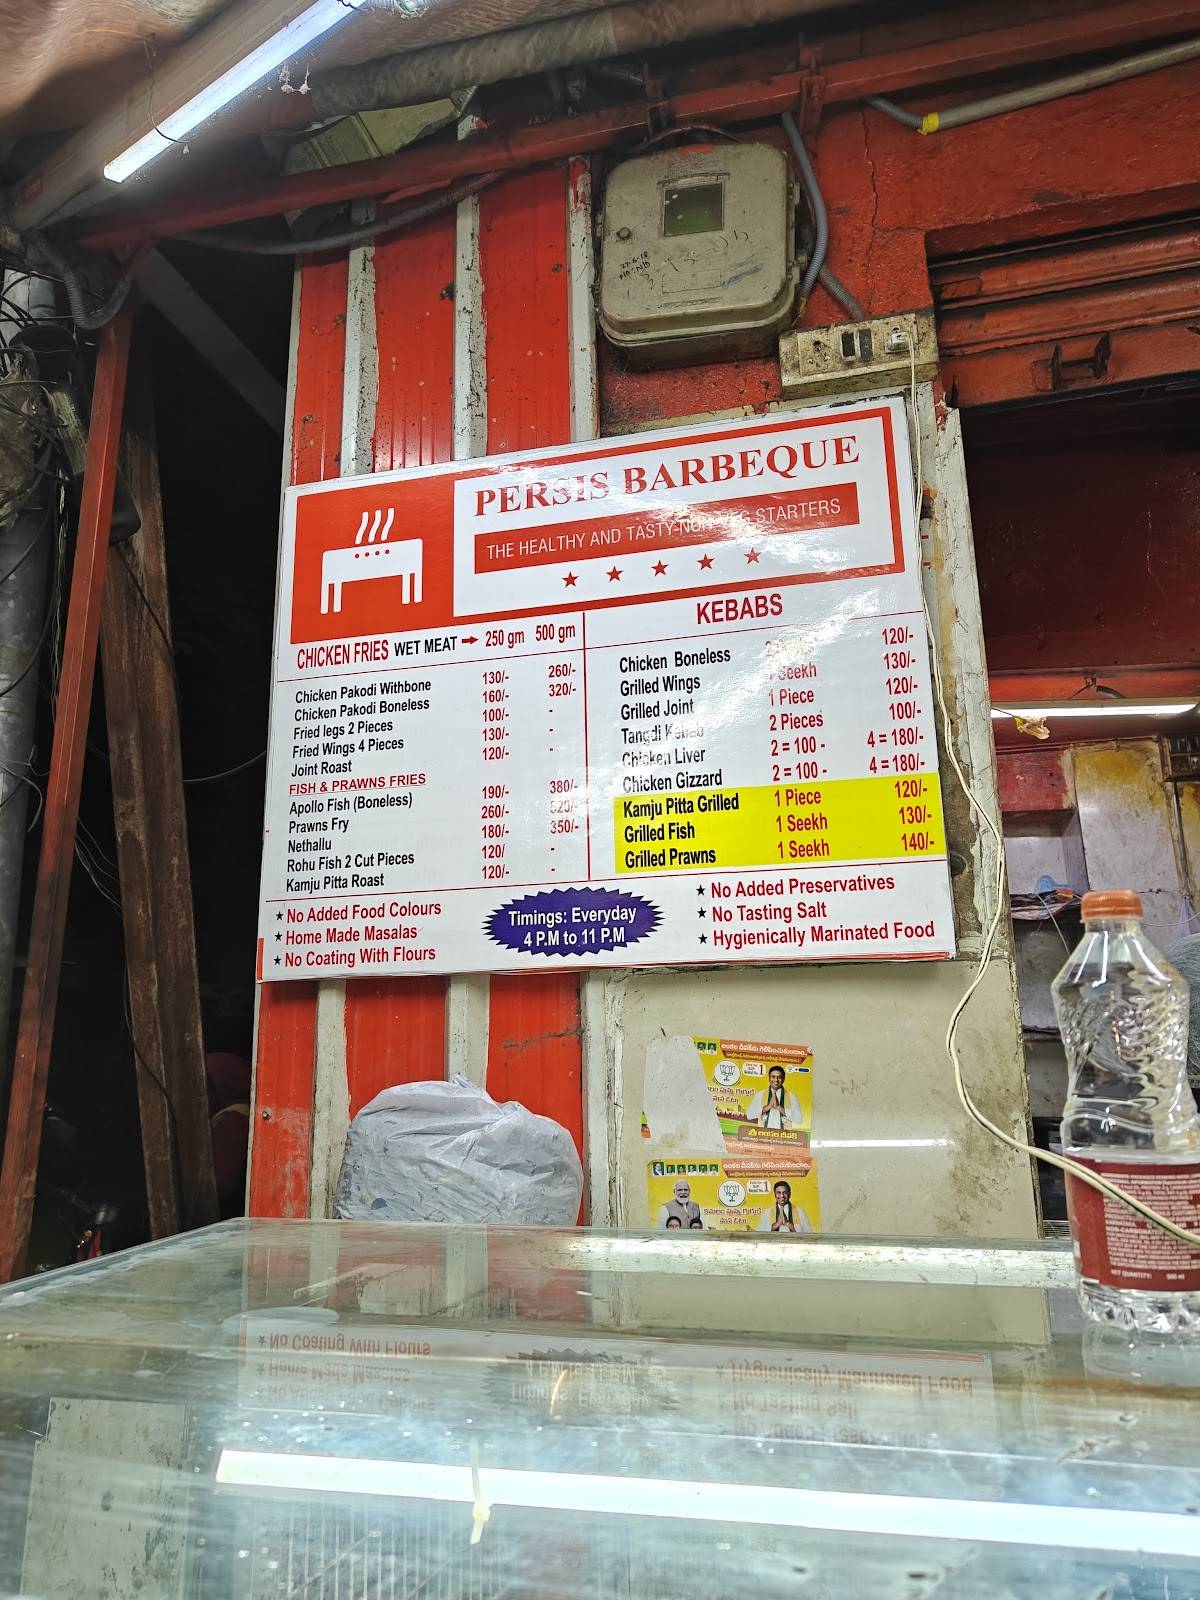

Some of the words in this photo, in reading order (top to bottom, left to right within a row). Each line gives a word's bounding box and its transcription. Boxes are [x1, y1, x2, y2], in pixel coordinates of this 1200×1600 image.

[474, 472, 609, 516] PERSIS
[624, 436, 859, 494] BARBEQUE
[487, 543, 514, 559] THE
[519, 532, 586, 555] HEALTHY
[590, 529, 621, 545] AND
[756, 498, 841, 523] STARTERS
[697, 593, 782, 624] KEBABS
[297, 644, 350, 669] CHICKEN
[354, 639, 388, 663] FRIES
[394, 640, 421, 656] WET
[425, 636, 457, 653] MEAT
[486, 629, 504, 647] 250
[508, 631, 524, 649] gm
[536, 624, 554, 641] 500
[558, 625, 575, 643] gm
[620, 655, 667, 673] Chicken
[675, 648, 730, 667] Boneless
[882, 626, 913, 645] 120/-
[296, 689, 337, 703] Chicken
[341, 683, 376, 699] Pakodi
[380, 680, 431, 695] Withbone
[483, 670, 509, 684] 130/-
[548, 663, 576, 678] 260/-
[620, 677, 659, 696] Grilled
[662, 675, 700, 694] Wings
[884, 651, 916, 669] 130/-
[295, 707, 336, 721] Chicken
[340, 702, 376, 717] Pakodi
[380, 698, 429, 713] Boneless
[483, 689, 509, 703] 160/-
[549, 682, 576, 697] 320/-
[621, 701, 660, 720] Grilled
[664, 698, 694, 716] Joint
[769, 689, 774, 706] 1
[780, 688, 814, 705] Piece
[886, 676, 918, 695] 120/-
[294, 725, 320, 740] Fried
[323, 724, 345, 739] legs
[348, 722, 354, 734] 2
[358, 721, 393, 733] Pieces
[483, 707, 509, 722] 100/-
[770, 714, 777, 731] 2
[781, 713, 823, 730] Pieces
[889, 701, 921, 720] 100/-
[293, 744, 319, 758] Fried
[322, 742, 355, 757] Wings
[358, 739, 365, 752] 4
[368, 738, 404, 751] Pieces
[483, 726, 509, 741] 130/-
[675, 747, 705, 764] Liver
[771, 740, 778, 756] 2
[782, 743, 790, 751] =
[794, 736, 816, 754] 100
[867, 731, 875, 748] 4
[879, 735, 887, 743] =
[892, 727, 923, 746] 180/-
[291, 763, 318, 777] Joint
[321, 760, 352, 774] Roast
[483, 746, 509, 760] 120/-
[623, 775, 672, 793] Chicken
[676, 769, 722, 789] Gizzard
[773, 764, 780, 781] 2
[784, 768, 792, 776] =
[796, 761, 818, 779] 100
[870, 756, 877, 773] 4
[881, 760, 889, 769] =
[893, 753, 925, 772] 180/-
[290, 782, 316, 796] FISH
[320, 782, 328, 792] &
[332, 777, 386, 792] PRAWNS
[388, 773, 426, 788] FRIES
[290, 800, 324, 817] Apollo
[327, 797, 350, 811] Fish
[351, 790, 412, 813] (Boneless)
[482, 784, 509, 799] 190/-
[550, 779, 578, 794] 380/-
[624, 799, 662, 820] Kamju
[666, 797, 694, 815] Pitta
[698, 793, 739, 812] Grilled
[775, 790, 780, 807] 1
[786, 788, 821, 806] Piece
[895, 779, 927, 798] 120/-
[289, 821, 328, 834] Prawns
[332, 817, 349, 833] Fry
[482, 804, 509, 819] 260/-
[625, 823, 665, 843] Grilled
[668, 821, 695, 840] Fish
[776, 815, 782, 832] 1
[787, 812, 827, 832] Seekh
[899, 805, 932, 824] 130/-
[288, 837, 331, 853] Nethallu
[482, 824, 509, 838] 180/-
[551, 819, 579, 834] 350/-
[625, 849, 666, 868] Grilled
[670, 848, 716, 865] Prawns
[778, 841, 783, 858] 1
[789, 838, 829, 858] Seekh
[902, 832, 934, 851] 140/-
[287, 858, 315, 872] Rohu
[319, 856, 341, 870] Fish
[345, 855, 351, 868] 2
[355, 853, 374, 867] Cut
[378, 852, 414, 866] Pieces
[482, 844, 505, 859] 120/
[287, 877, 320, 894] Kamju
[324, 876, 348, 890] Pitta
[352, 873, 384, 887] Roast
[482, 864, 509, 879] 120/-
[711, 882, 731, 898] No
[735, 879, 784, 897] Added
[789, 874, 895, 894] Preservatives
[287, 909, 304, 923] No
[307, 905, 348, 922] Added
[353, 903, 385, 919] Food
[390, 901, 441, 917] Colours
[509, 910, 567, 927] Timings:
[572, 905, 636, 924] Everyday
[713, 906, 732, 922] No
[737, 904, 792, 923] Tasting
[797, 901, 827, 918] Salt
[286, 930, 321, 945] Home
[326, 927, 360, 943] Made
[365, 924, 417, 941] Masalas
[524, 932, 532, 947] 4
[536, 930, 559, 946] P.M
[564, 930, 577, 944] to
[582, 929, 595, 944] 11
[601, 927, 625, 943] P.M
[714, 927, 805, 950] Hygienically
[811, 923, 888, 942] Marinated
[894, 921, 934, 938] Food
[285, 952, 302, 967] No
[306, 950, 355, 968] Coating
[360, 948, 388, 963] With
[394, 946, 435, 961] Flours
